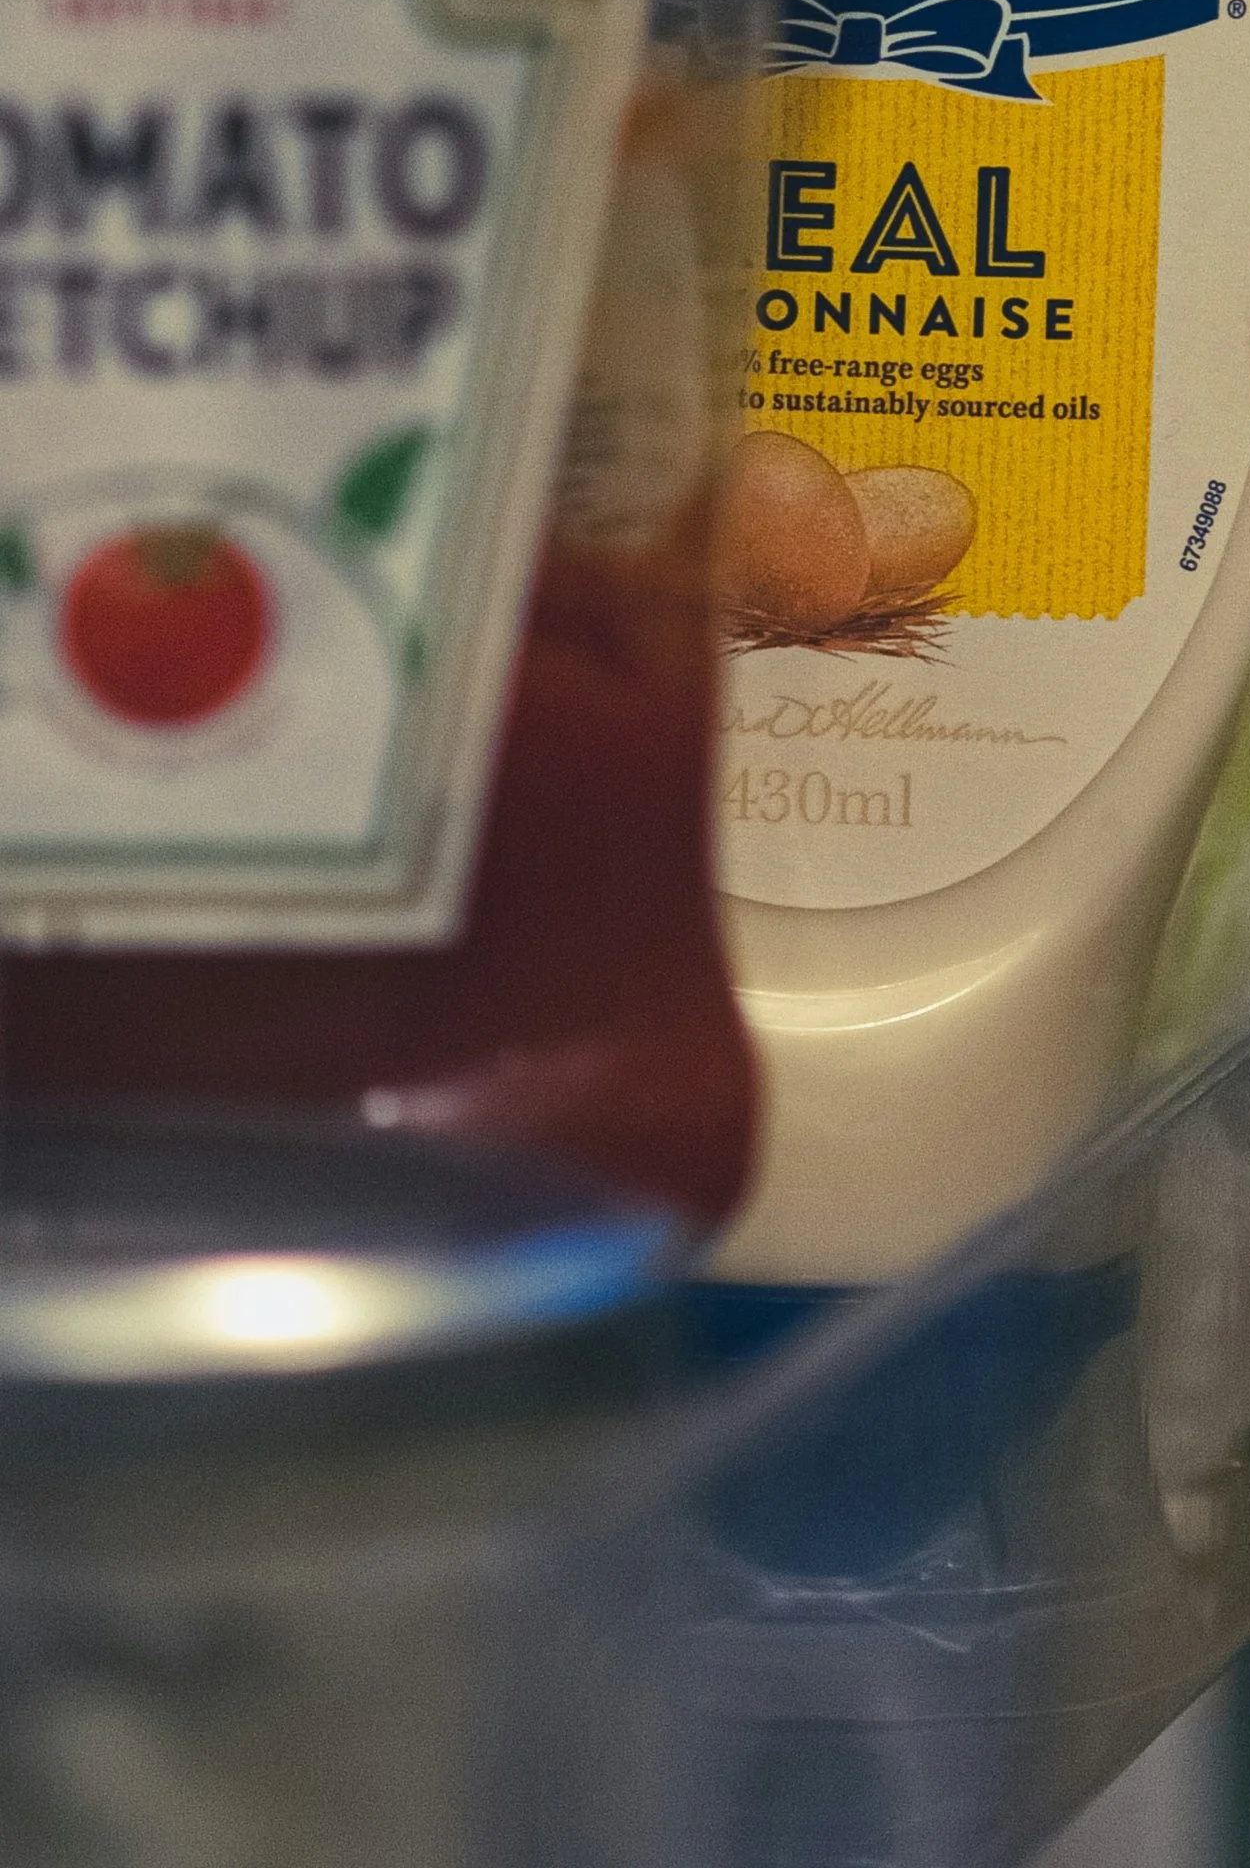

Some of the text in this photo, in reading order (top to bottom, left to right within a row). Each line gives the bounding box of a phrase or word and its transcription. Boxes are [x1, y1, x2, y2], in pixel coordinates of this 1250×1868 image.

[765, 159, 1046, 279] EAL
[0, 262, 460, 382] TCHUP
[755, 288, 1075, 341] ONNAISE
[767, 349, 913, 387] free-range
[920, 362, 984, 390] eggs
[739, 388, 1101, 423] to sustainably sourced oils
[1179, 479, 1227, 572] 67349088
[722, 768, 913, 827] 430ml
